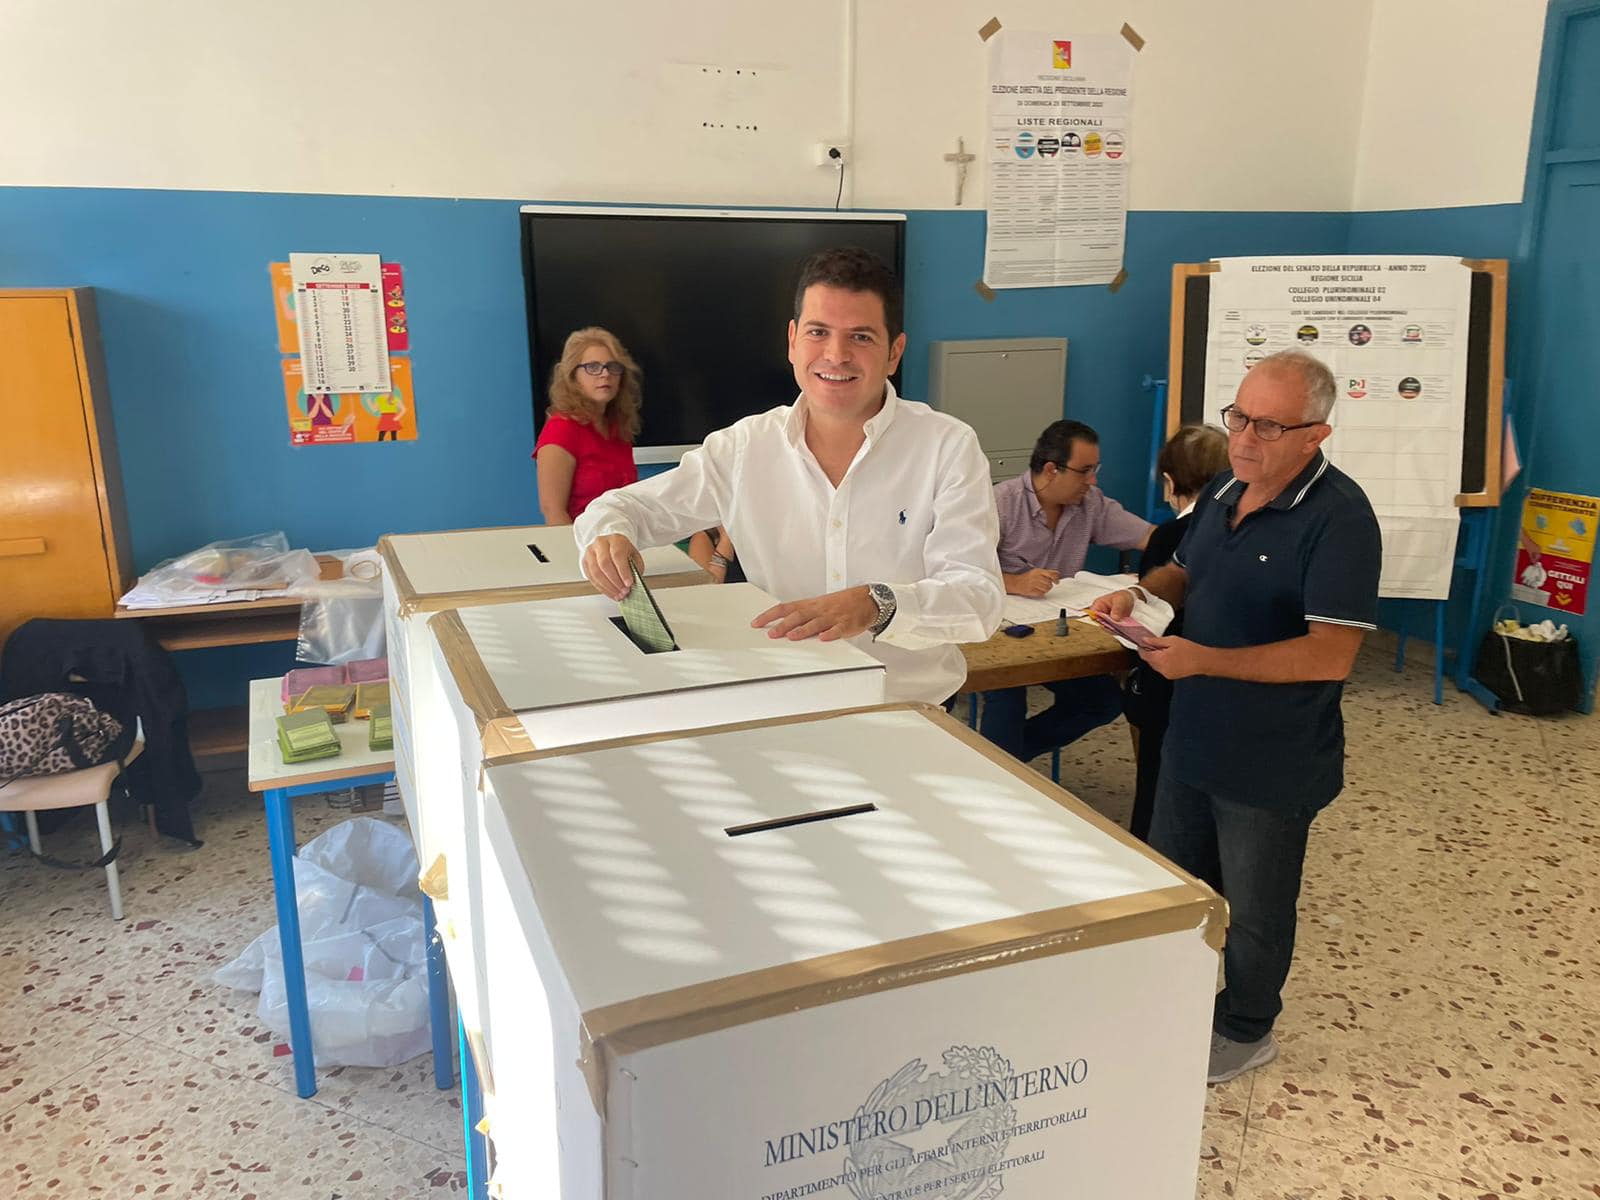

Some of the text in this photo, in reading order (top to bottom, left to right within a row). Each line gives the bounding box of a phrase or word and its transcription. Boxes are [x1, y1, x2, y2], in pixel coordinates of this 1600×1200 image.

[1017, 118, 1102, 127] LISTE REGIONALI
[1295, 264, 1321, 272] SENATO
[1322, 264, 1341, 272] DELLA
[1342, 264, 1381, 272] REPUBBLICA
[1388, 264, 1408, 272] ANNO
[1288, 286, 1320, 294] COLLEGIO
[1556, 580, 1574, 591] QUI
[764, 1058, 1088, 1168] MINISTERO DELL'INTERNO
[859, 1163, 882, 1178] PER
[885, 1157, 905, 1172] GLI
[909, 1142, 950, 1166] AFFARI
[949, 1131, 1000, 1154] INTERNI
[1012, 1107, 1088, 1137] TERRITORIALI
[872, 1184, 922, 1200] NTRALE
[923, 1179, 942, 1193] PER
[949, 1166, 986, 1185] SERVIZI
[988, 1150, 1045, 1175] ELETTORALI
